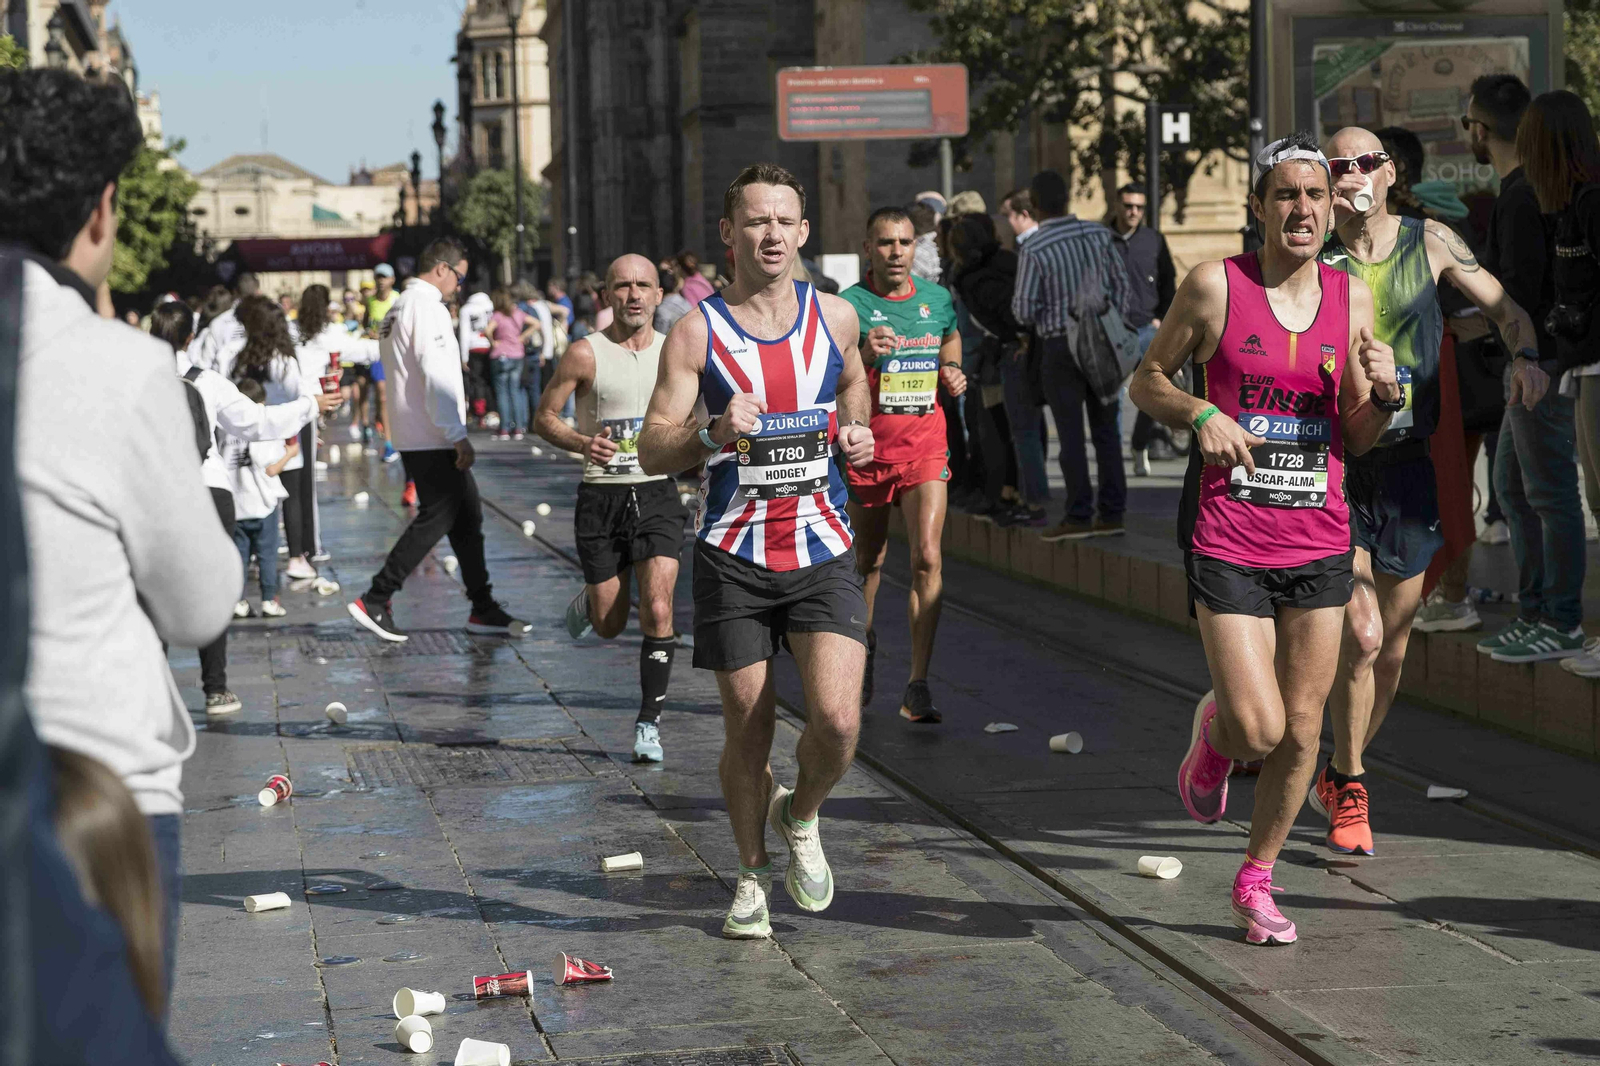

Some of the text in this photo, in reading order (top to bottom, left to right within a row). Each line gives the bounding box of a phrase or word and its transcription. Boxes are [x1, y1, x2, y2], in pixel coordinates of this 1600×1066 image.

[1162, 112, 1190, 144] H
[1426, 162, 1494, 183] SOHO
[901, 360, 936, 371] ZURICH
[901, 379, 925, 389] 1127
[1241, 373, 1275, 386] CLUB
[766, 414, 819, 431] ZURICH
[1271, 421, 1322, 436] ZURICH
[768, 446, 805, 462] 1780
[1269, 452, 1304, 468] 1728
[765, 467, 807, 481] HODGEY
[1247, 472, 1315, 487] OSCAR-ALMA
